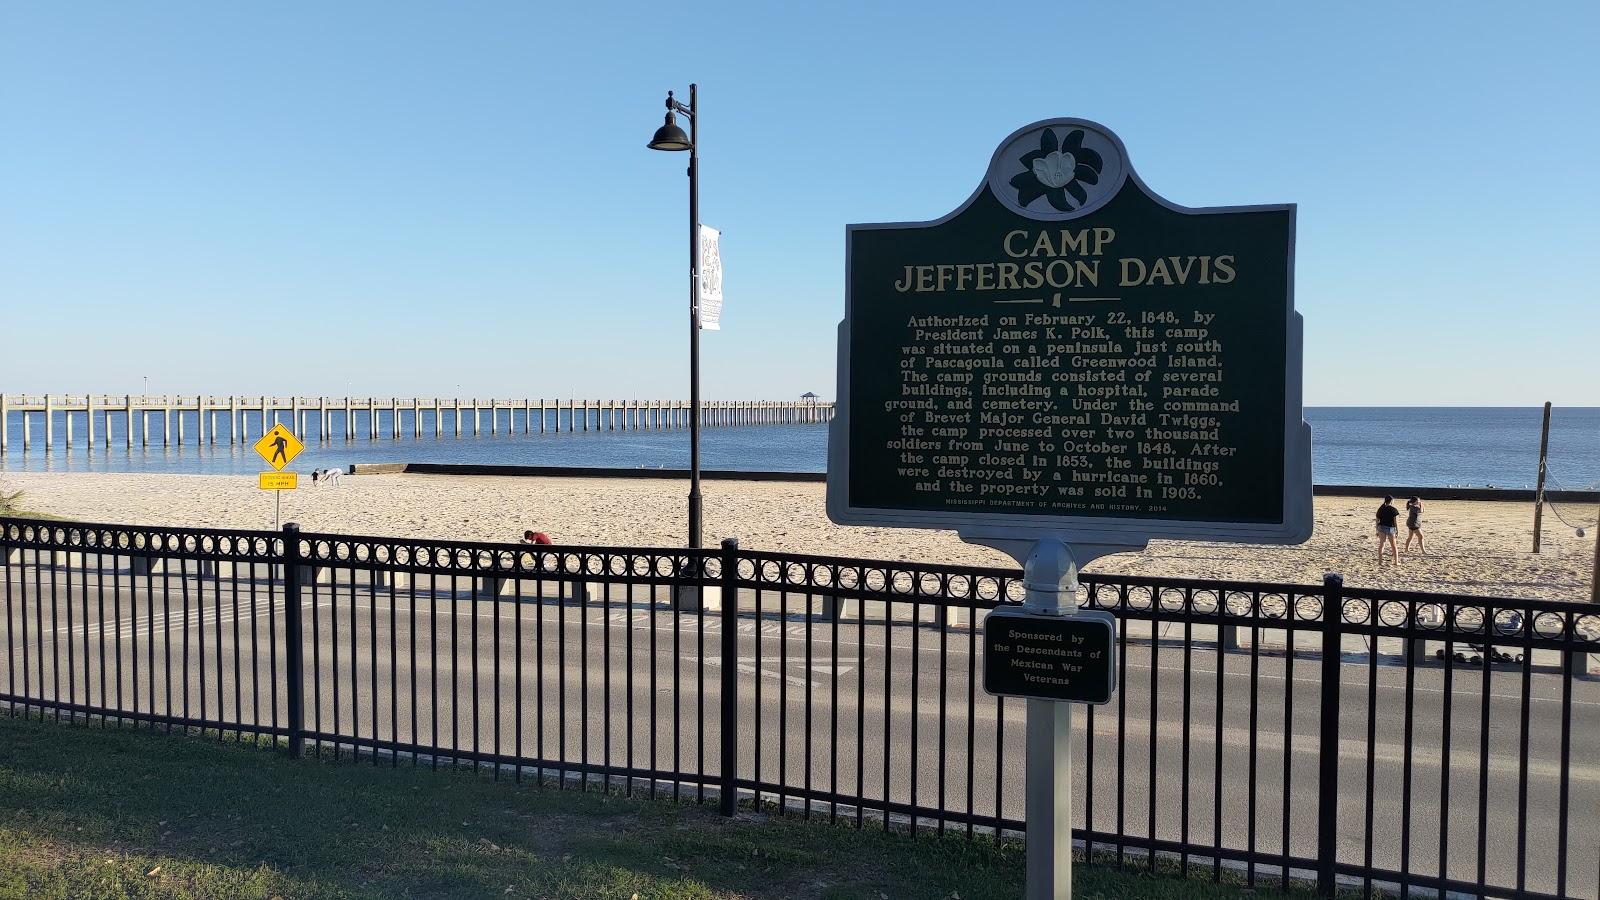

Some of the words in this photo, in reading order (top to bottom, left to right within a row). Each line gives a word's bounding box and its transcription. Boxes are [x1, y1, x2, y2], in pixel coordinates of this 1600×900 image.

[1004, 228, 1115, 258] CAMP
[895, 259, 1100, 292] JEFFERSON
[1118, 255, 1236, 286] DAVIS
[907, 314, 989, 327] Authorized
[999, 317, 1017, 326] on
[1025, 313, 1096, 326] February
[1107, 312, 1131, 325] 22,
[1193, 310, 1215, 325] by
[915, 328, 984, 341] President
[993, 328, 1037, 340] James
[1046, 327, 1062, 339] K.
[1124, 326, 1154, 338] this
[1165, 329, 1208, 341] camp
[902, 346, 926, 355] was
[933, 342, 994, 354] situated
[1003, 345, 1020, 354] on
[1028, 345, 1037, 354] a
[1046, 341, 1123, 356] peninsula
[1134, 341, 1167, 356] just
[1176, 340, 1222, 353] south
[900, 357, 916, 368] of
[925, 356, 1004, 371] Pascagoula
[1014, 356, 1060, 368] called
[1072, 355, 1157, 367] Greenwood
[901, 370, 928, 382] The
[937, 373, 973, 384] camp
[983, 370, 1042, 384] grounds
[1052, 369, 1125, 382] consisted
[1135, 370, 1152, 382] of
[1163, 370, 1222, 382] several
[982, 384, 1051, 398] including
[1060, 387, 1068, 396] a
[1078, 384, 1147, 399] hospital,
[1162, 384, 1219, 399] parade
[885, 398, 938, 412] ground,
[947, 397, 973, 410] and
[982, 398, 1058, 412] cemetery.
[1072, 398, 1117, 411] Under
[1129, 399, 1154, 411] the
[1164, 400, 1240, 412] command
[900, 411, 916, 423] of
[925, 411, 971, 423] Brevet
[980, 411, 1024, 426] Major
[1032, 412, 1090, 424] General
[1100, 412, 1147, 425] David
[901, 425, 924, 436] the
[931, 427, 968, 439] camp
[979, 426, 1053, 439] processed
[1061, 429, 1096, 439] over
[1106, 427, 1135, 439] two
[1145, 427, 1219, 440] thousand
[887, 438, 941, 450] soldiers
[948, 439, 984, 451] from
[994, 439, 1029, 452] June
[1038, 440, 1055, 452] to
[1064, 441, 1127, 454] October
[1137, 442, 1177, 455] 1848.
[1190, 443, 1236, 456] After
[900, 452, 924, 463] the
[932, 456, 969, 467] camp
[979, 453, 1025, 466] closed
[1033, 455, 1047, 466] in
[1105, 456, 1132, 469] the
[1142, 457, 1219, 474] buildings
[897, 468, 930, 477] were
[937, 466, 1013, 480] destroyed
[1022, 468, 1042, 482] by
[1053, 472, 1061, 481] a
[1072, 469, 1148, 483] hurricane
[1157, 472, 1172, 484] in
[915, 480, 940, 491] and
[949, 480, 973, 492] the
[980, 483, 1050, 497] property
[1057, 487, 1084, 496] was
[1095, 485, 1126, 497] sold
[1136, 486, 1153, 498] in
[1162, 487, 1201, 500] 1903.
[989, 499, 1035, 507] DEPARTMENT
[1008, 629, 1062, 642] Sponsored
[1071, 634, 1084, 644] by
[994, 644, 1010, 652] the
[1017, 645, 1082, 658] Descendants
[1090, 650, 1101, 659] of
[1011, 658, 1053, 670] Mexican
[1062, 663, 1083, 672] War
[1023, 673, 1069, 685] Veterans
